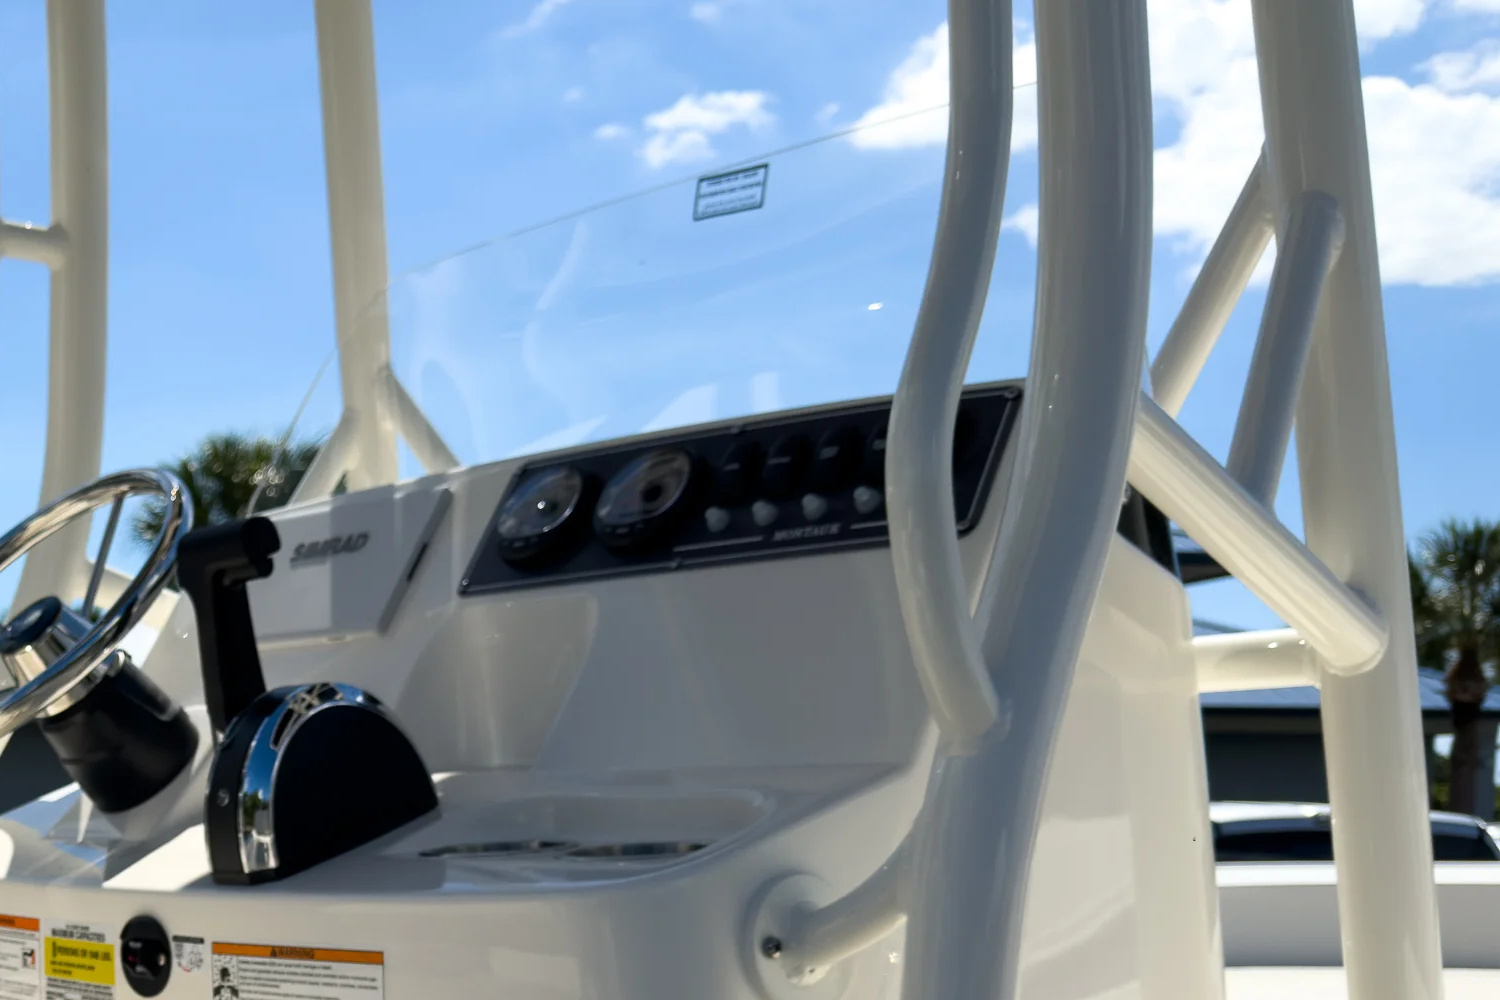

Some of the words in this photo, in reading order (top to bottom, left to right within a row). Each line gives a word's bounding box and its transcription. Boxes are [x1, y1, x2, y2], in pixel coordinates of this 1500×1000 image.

[773, 523, 841, 540] MONTAUK
[290, 532, 369, 562] SIMRAD
[278, 947, 314, 960] WARNING
